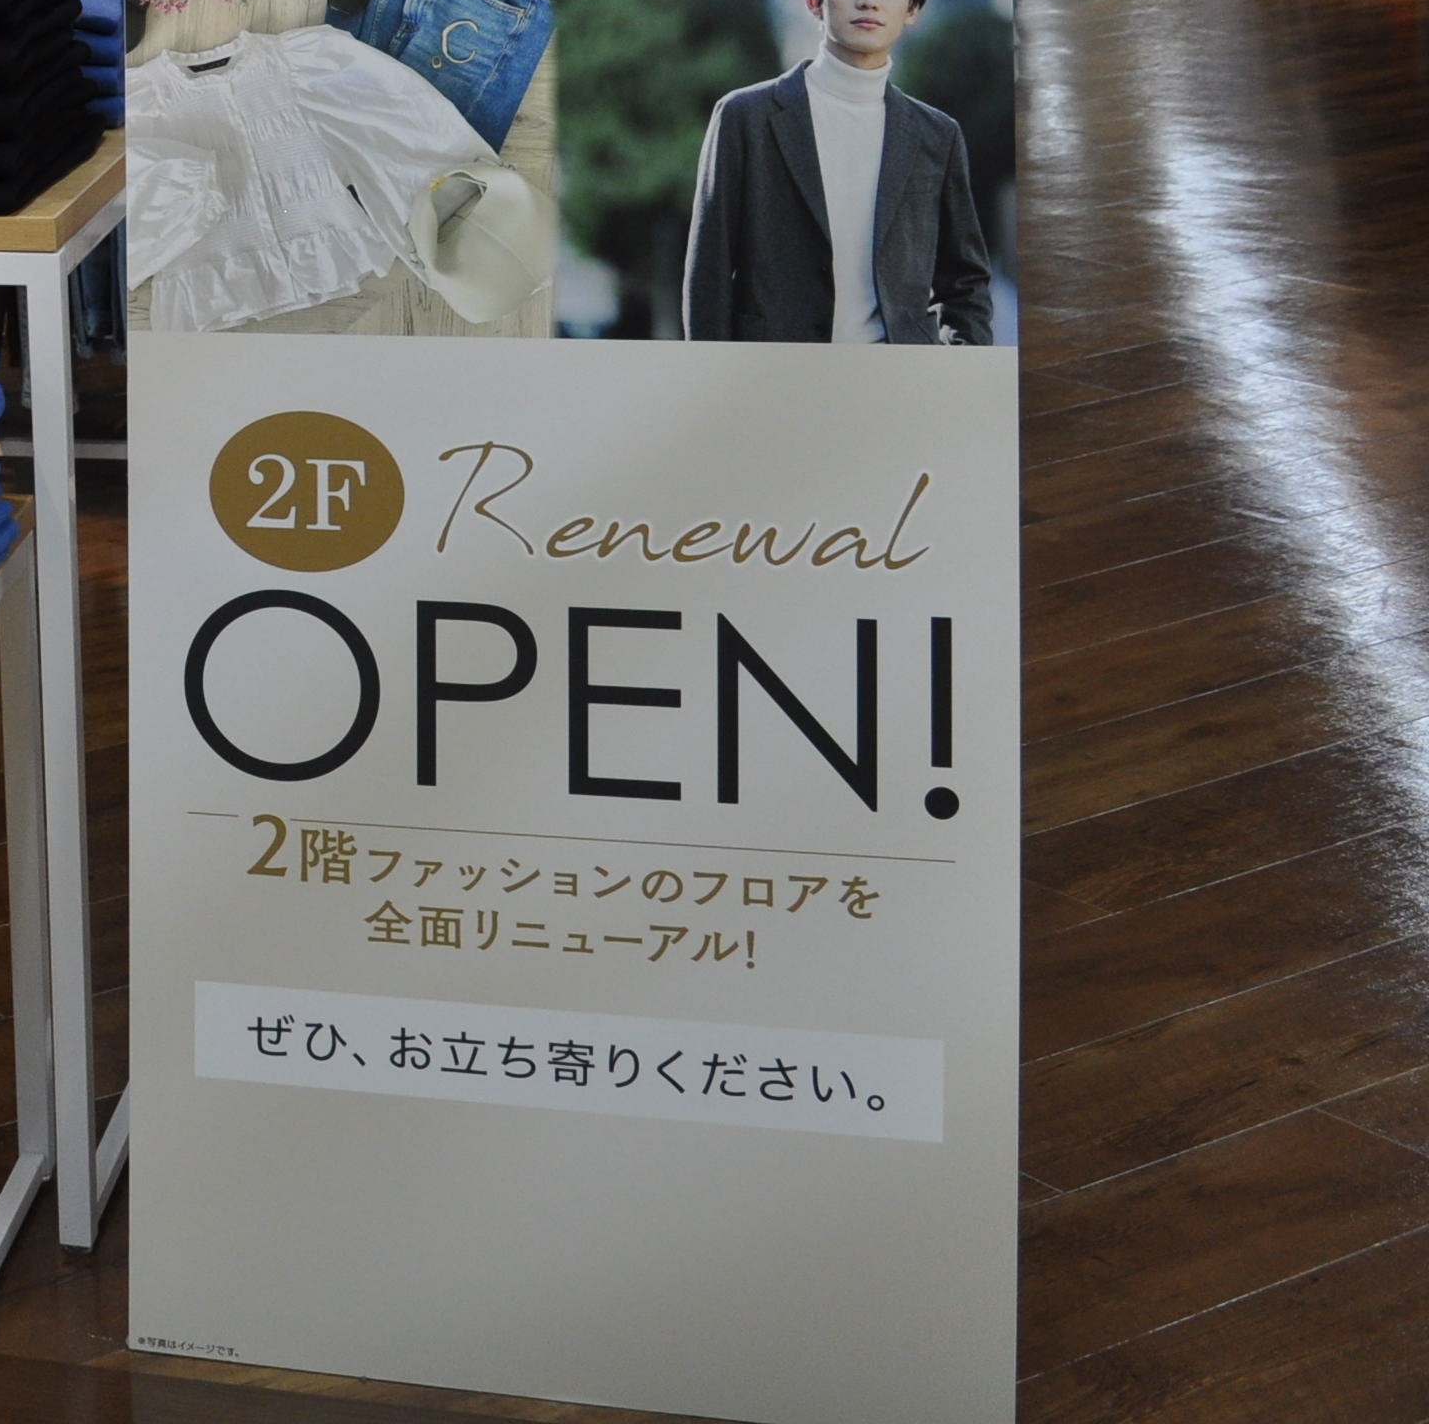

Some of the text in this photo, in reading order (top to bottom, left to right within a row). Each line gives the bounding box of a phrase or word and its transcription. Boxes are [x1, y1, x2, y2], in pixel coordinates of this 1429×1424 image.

[245, 440, 931, 572] 2F Renewal
[183, 588, 961, 821] OPEN!
[246, 812, 883, 921] 2階ファッションのフロアを
[363, 899, 759, 971] 全面リニューアル!
[246, 1013, 889, 1114] ぜひ、お立ち寄りください。
